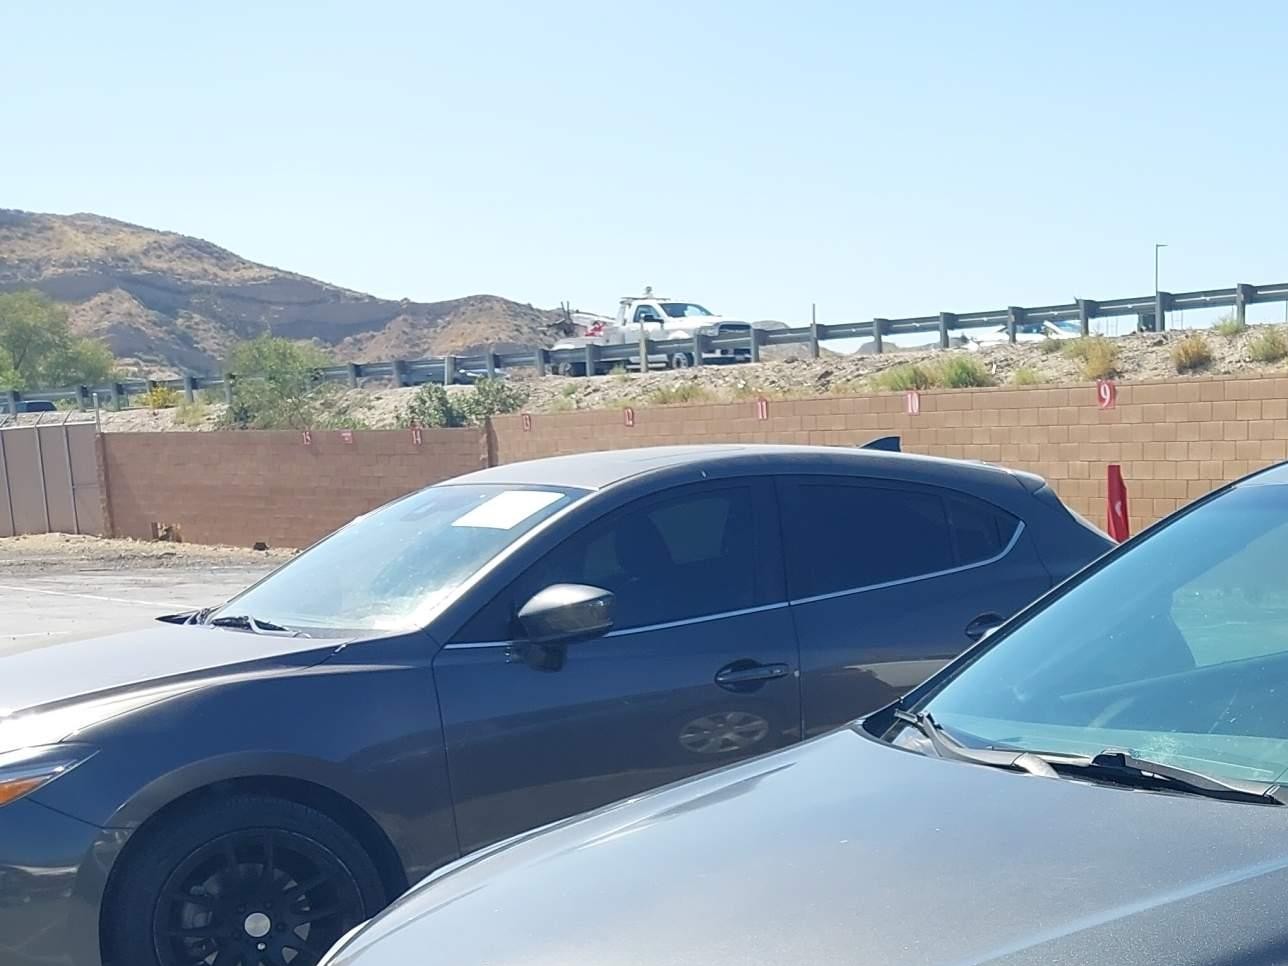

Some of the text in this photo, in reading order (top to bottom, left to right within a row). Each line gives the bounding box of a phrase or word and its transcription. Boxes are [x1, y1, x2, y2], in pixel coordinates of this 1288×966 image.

[907, 391, 919, 414] 10
[1100, 383, 1111, 408] 9
[757, 400, 768, 420] 11
